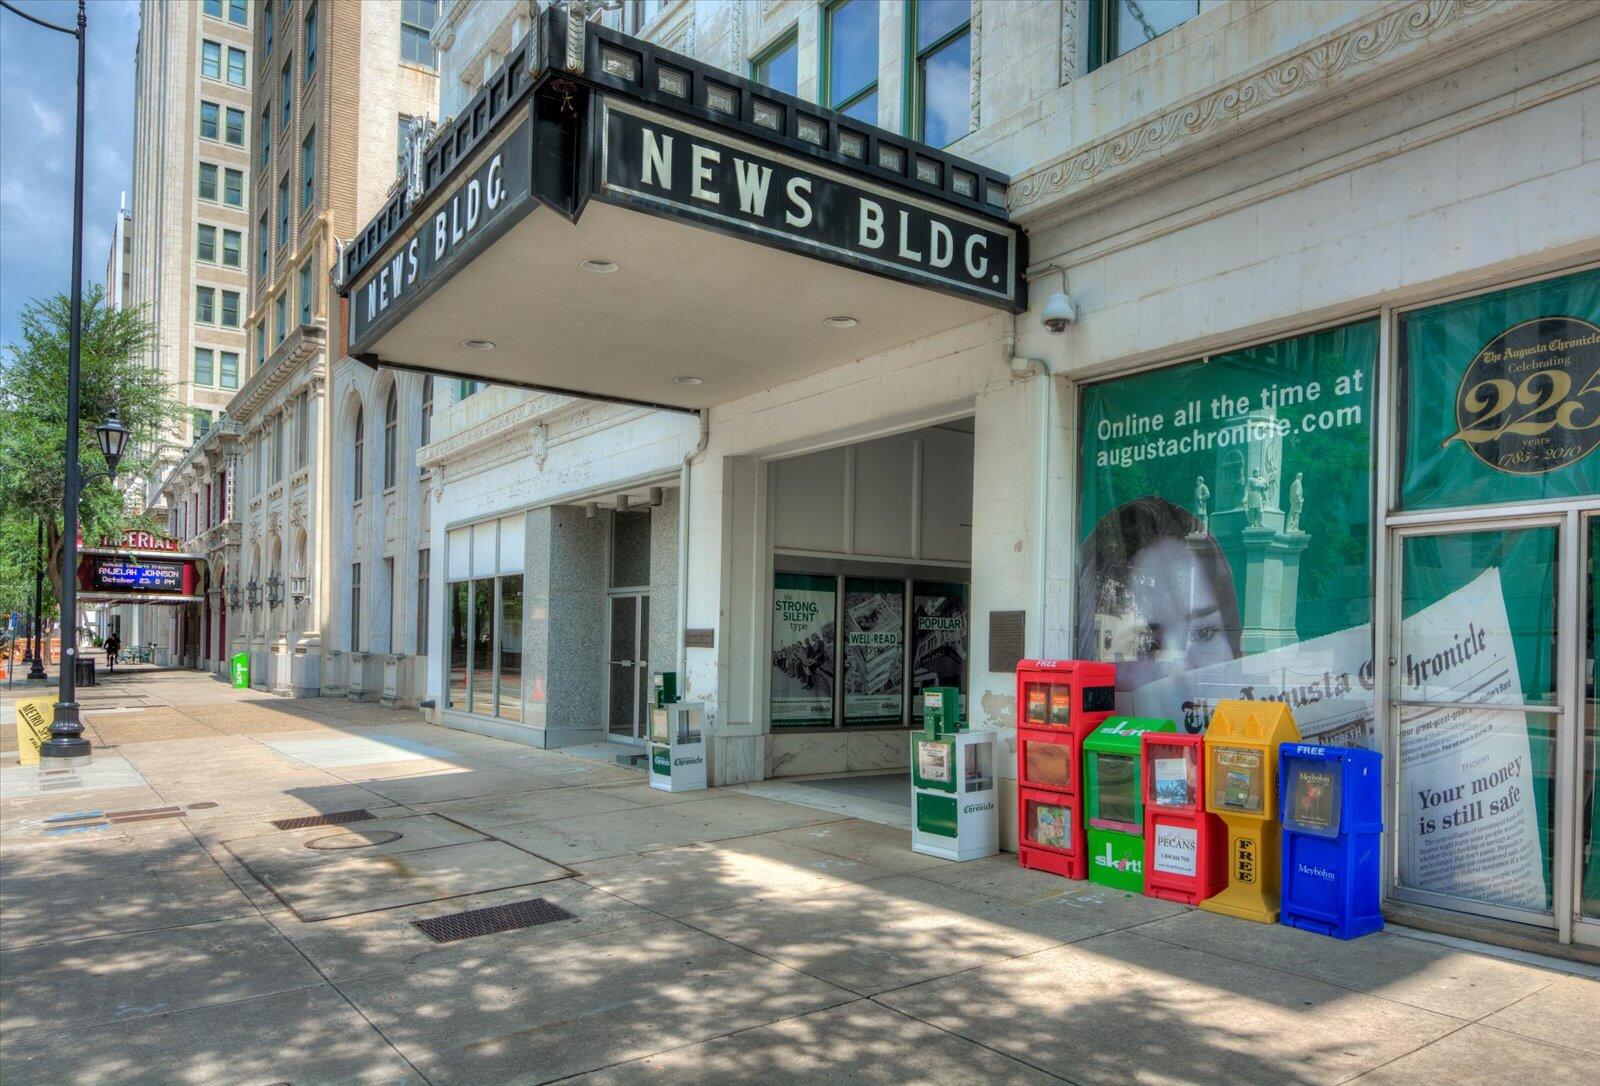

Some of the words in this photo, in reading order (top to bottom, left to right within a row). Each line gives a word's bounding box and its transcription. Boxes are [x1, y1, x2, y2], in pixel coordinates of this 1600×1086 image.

[641, 127, 813, 228] NEWS
[858, 197, 1000, 284] BLDG.
[368, 238, 418, 322] NEWS
[435, 154, 507, 261] BLDG.
[1483, 352, 1501, 363] The
[1503, 343, 1547, 361] Augusta
[1508, 355, 1572, 374] Celebrating
[1097, 412, 1164, 440] Online
[1173, 400, 1201, 427] all
[1211, 394, 1250, 420] the
[1260, 381, 1321, 410] time
[1334, 369, 1364, 396] at
[1097, 404, 1362, 468] augustachronicle.com
[98, 568, 137, 576] ANJELAH
[142, 569, 179, 578] JOHNSON
[775, 600, 819, 613] STRONG,
[783, 611, 815, 622] SILENT
[919, 618, 962, 629] POPULAR
[850, 633, 896, 645] WELL-READ
[1035, 660, 1058, 668] FREE
[21, 703, 45, 727] METRO
[1296, 745, 1326, 756] FREE
[1418, 785, 1465, 810] Your
[1471, 756, 1522, 795] money
[1419, 816, 1436, 836] is
[1442, 801, 1484, 829] still
[1489, 786, 1520, 816] safe
[1158, 837, 1196, 851] PECANS
[1238, 839, 1253, 883] FREE
[1298, 863, 1335, 881] Meybohm
